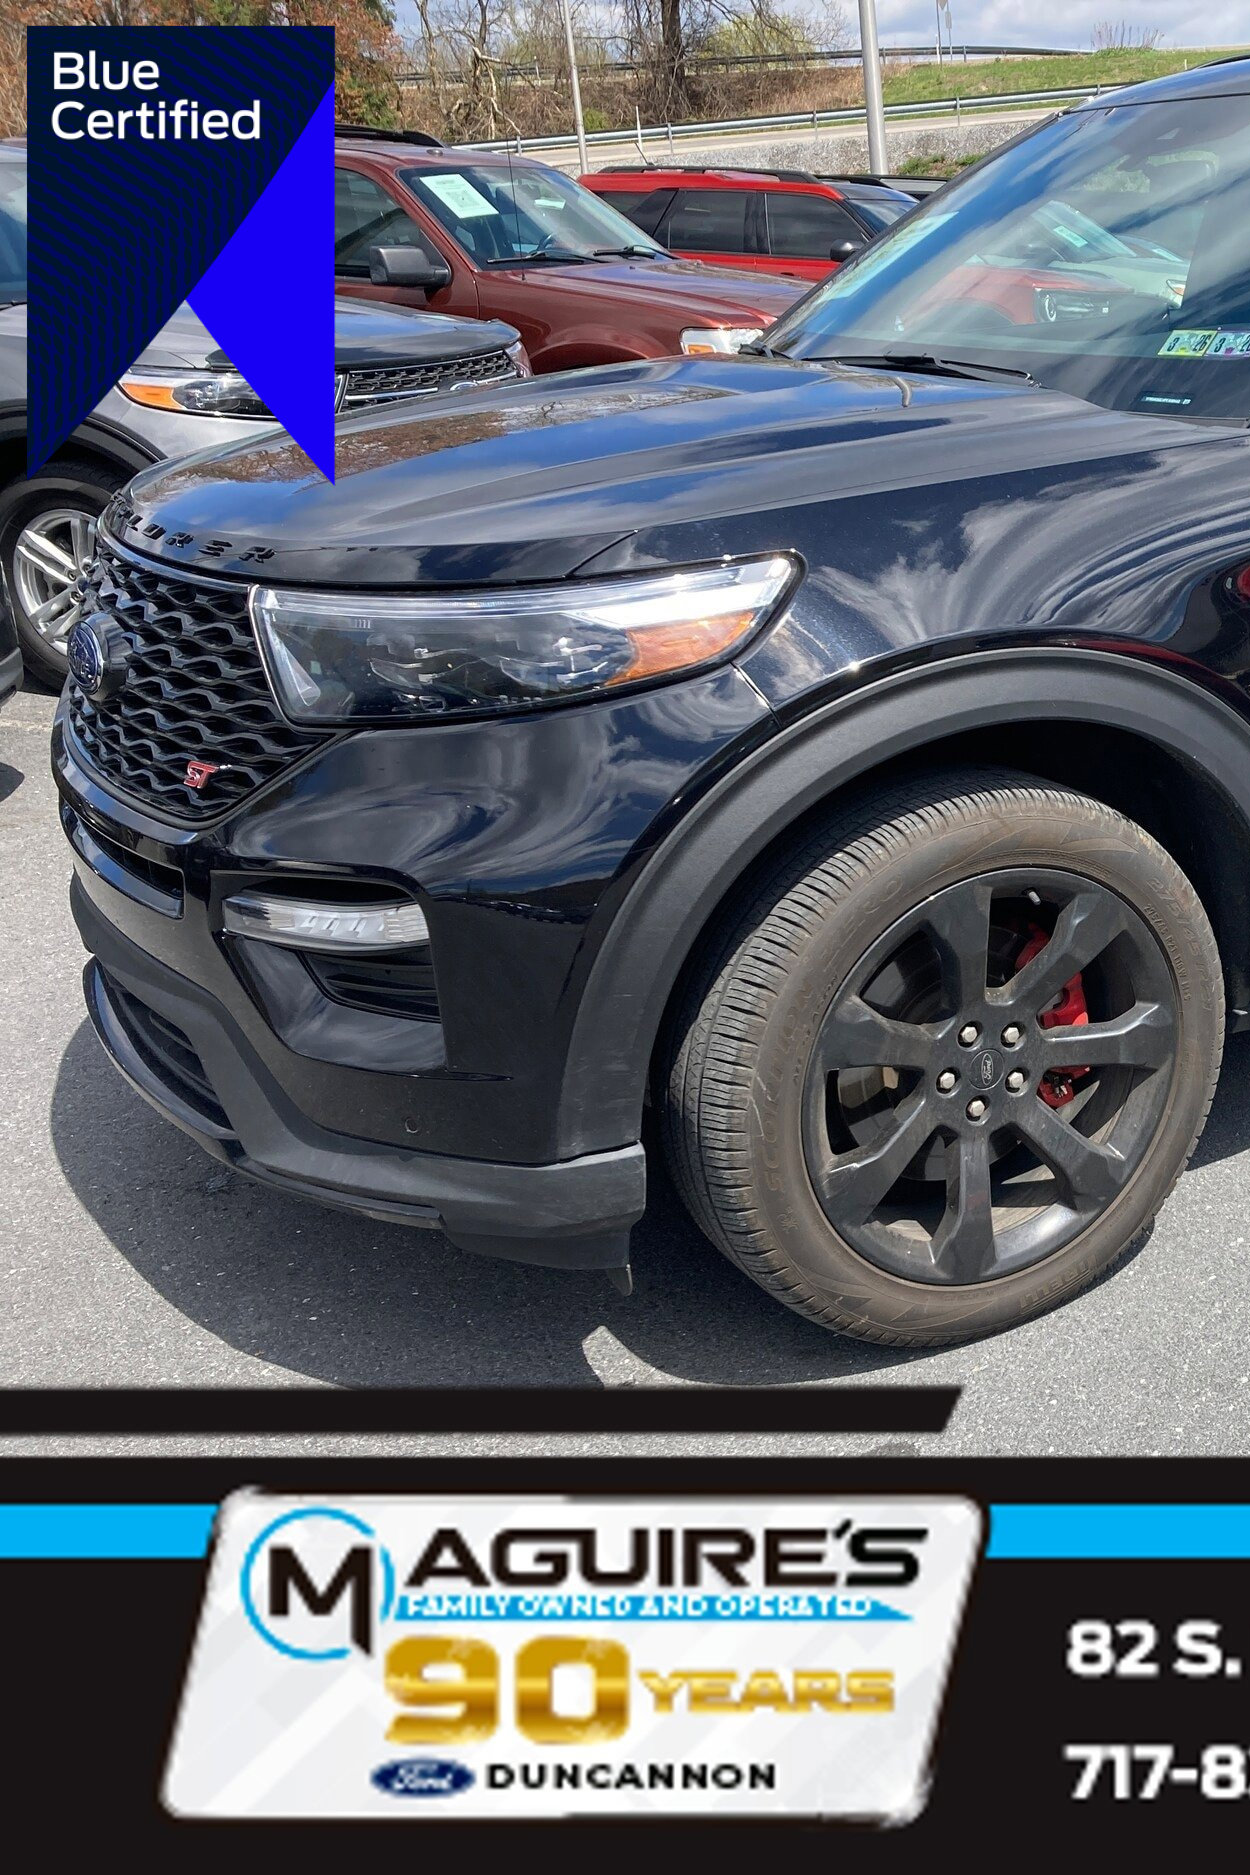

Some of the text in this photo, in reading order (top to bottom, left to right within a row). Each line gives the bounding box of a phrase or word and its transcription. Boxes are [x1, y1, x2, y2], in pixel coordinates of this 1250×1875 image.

[1167, 335, 1212, 352] 3 26
[1214, 337, 1226, 353] 3
[183, 760, 221, 789] ST
